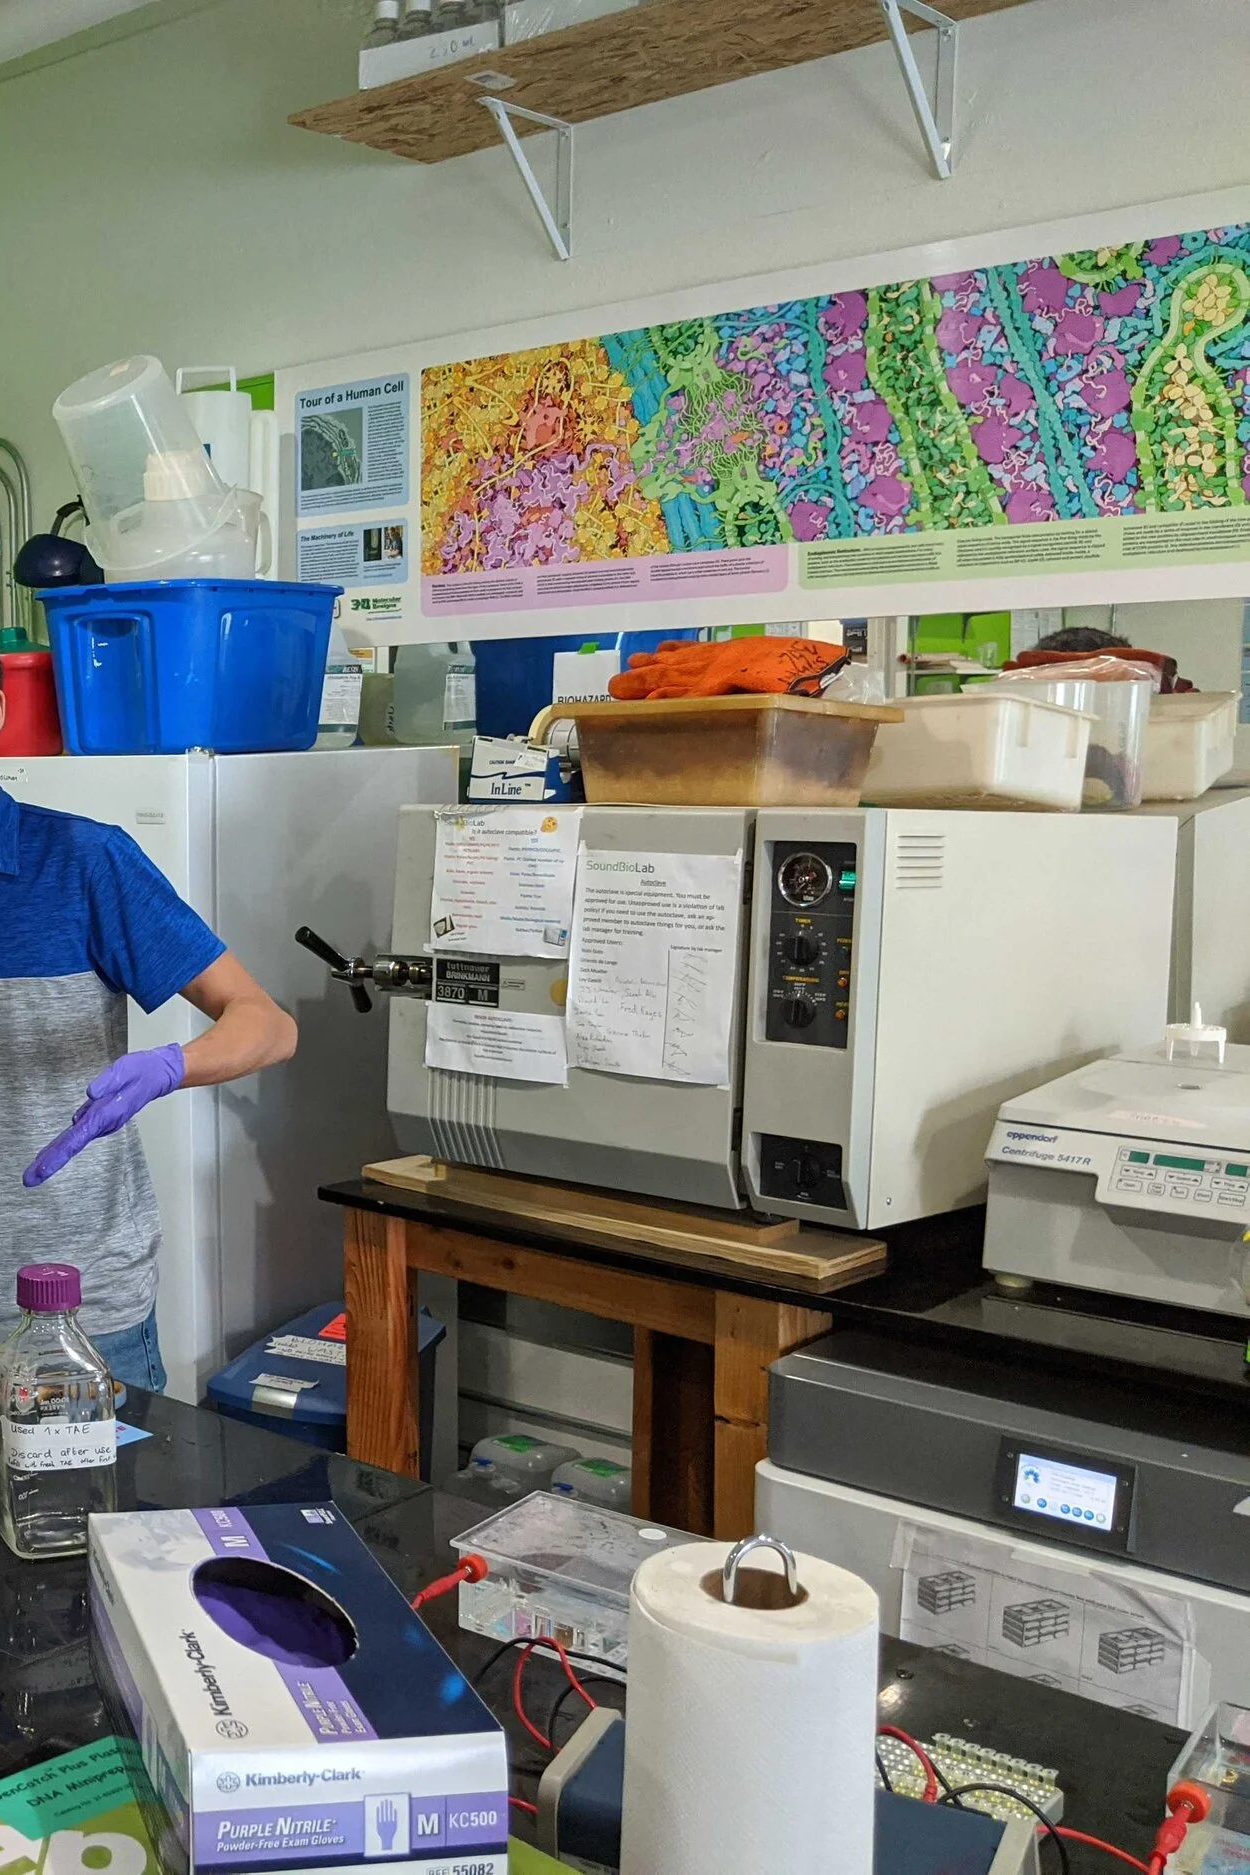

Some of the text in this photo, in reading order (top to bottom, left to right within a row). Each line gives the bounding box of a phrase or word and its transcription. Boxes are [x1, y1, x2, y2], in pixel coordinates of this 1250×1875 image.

[300, 381, 404, 409] Tour of a Human Cell
[311, 532, 336, 541] Machinery
[491, 783, 522, 795] InLine
[586, 860, 655, 873] SoundBioLab
[446, 971, 490, 982] BRINKMANN
[437, 985, 488, 1001] 3870 M
[1006, 1130, 1058, 1145] eppendorf
[1002, 1145, 1055, 1161] Centrifuge
[11, 1425, 35, 1435] Used
[66, 1424, 91, 1434] TAE
[11, 1446, 111, 1458] Discard after use
[220, 1535, 250, 1548] M
[179, 1629, 232, 1716] Kimberly-Clark
[58, 1759, 88, 1774] Plus
[245, 1767, 362, 1788] Kimberly-Clark
[26, 1766, 124, 1807] DNA Miniprep
[417, 1813, 439, 1836] M
[449, 1810, 498, 1829] KC500
[217, 1821, 273, 1840] PURPLE
[217, 1834, 345, 1852] Powder-Free Exam Gloves
[452, 1863, 494, 1875] 55082
